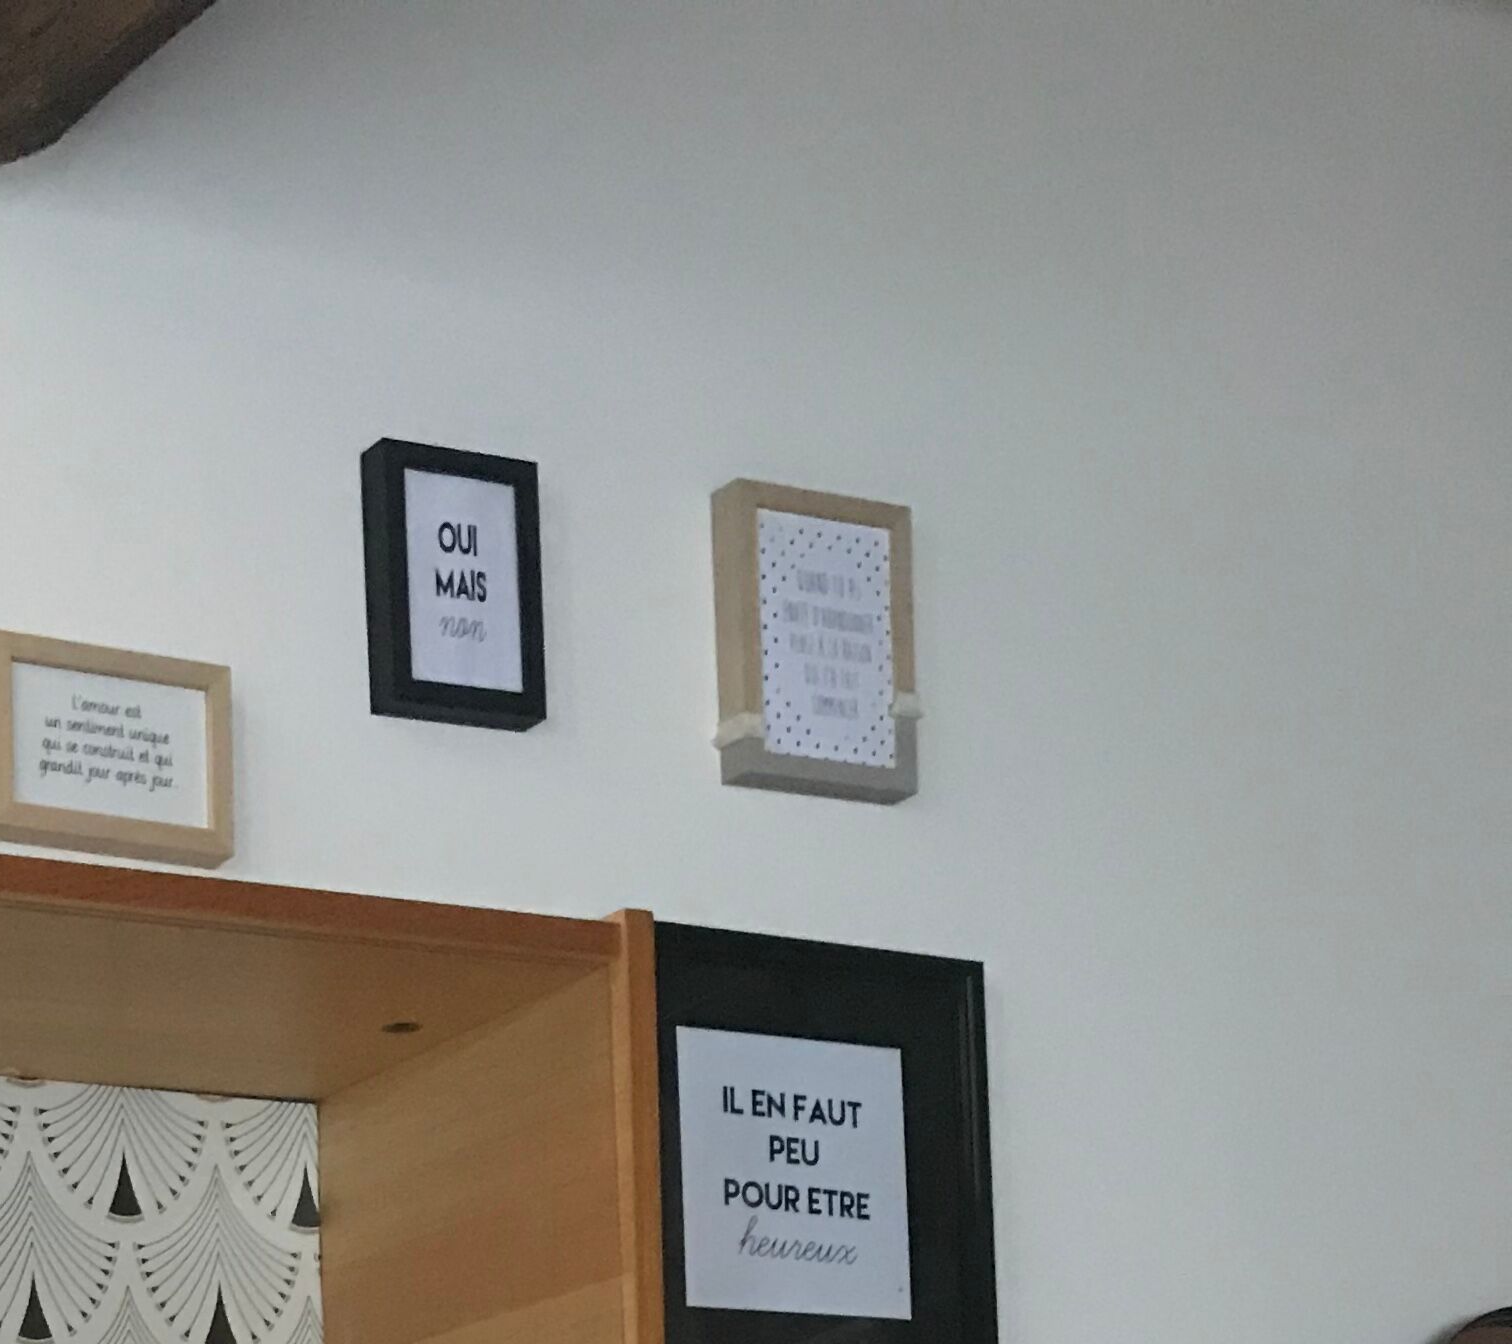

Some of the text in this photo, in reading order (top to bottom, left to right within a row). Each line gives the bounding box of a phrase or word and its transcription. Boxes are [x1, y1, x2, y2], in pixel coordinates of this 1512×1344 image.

[437, 520, 478, 557] OUI
[435, 568, 487, 603] MAIS
[438, 614, 487, 642] non
[66, 718, 125, 738] sentiment
[128, 727, 170, 750] unique
[39, 759, 84, 778] grandit
[42, 736, 62, 756] qui
[154, 752, 173, 771] qui
[722, 1085, 862, 1129] IL EN FAUT
[769, 1134, 820, 1166] PEU
[724, 1178, 870, 1220] POUR ETRE
[739, 1214, 858, 1266] heureux
